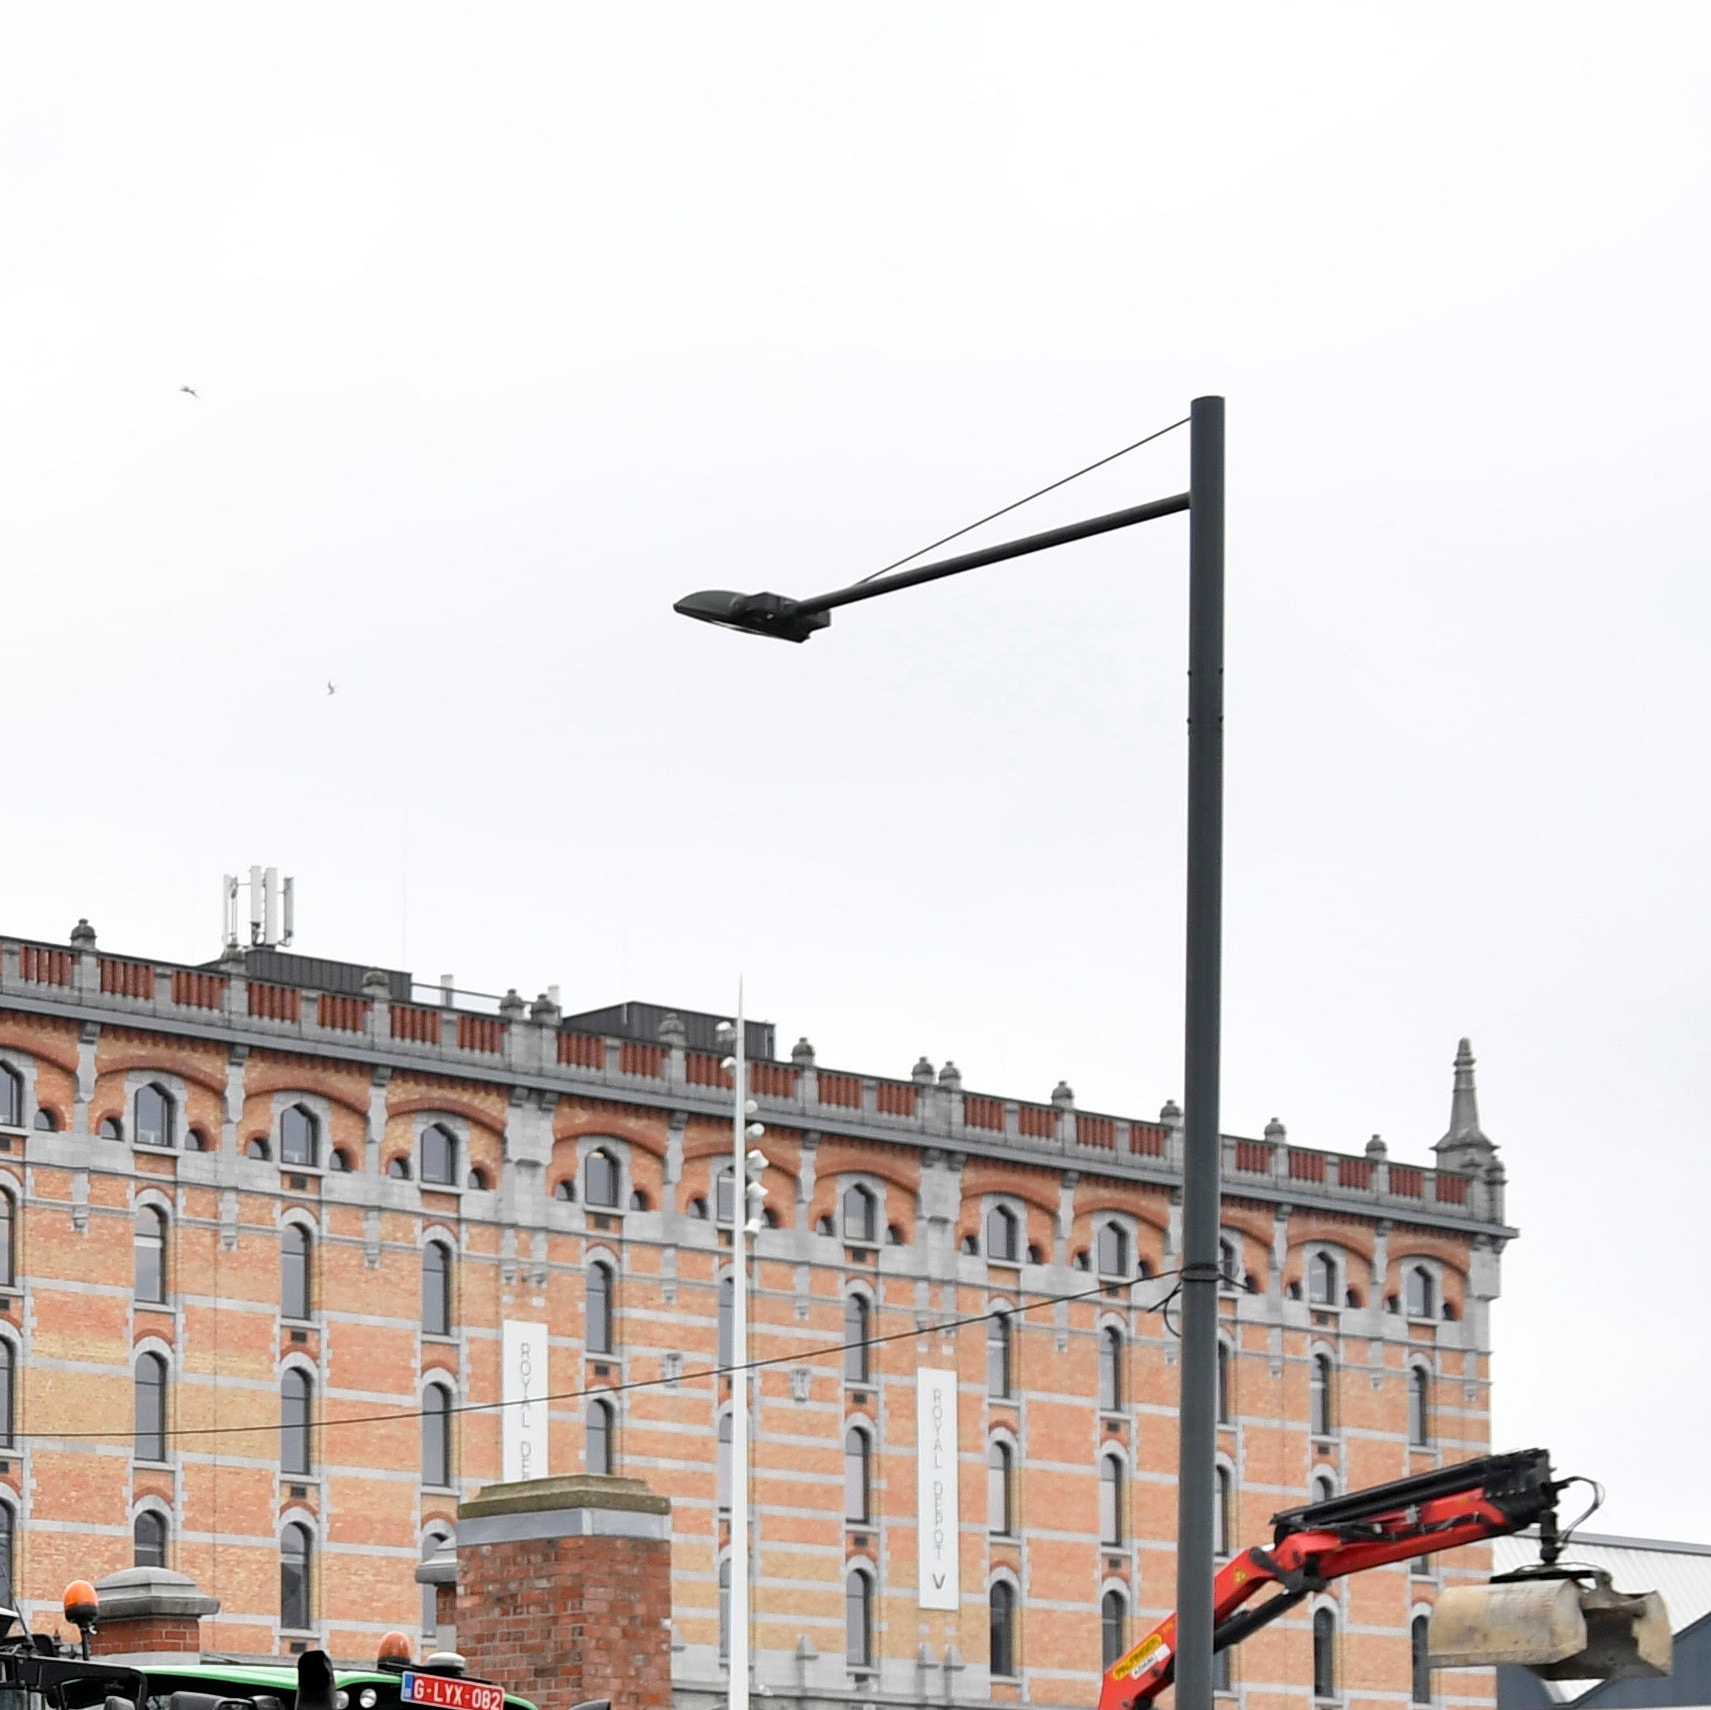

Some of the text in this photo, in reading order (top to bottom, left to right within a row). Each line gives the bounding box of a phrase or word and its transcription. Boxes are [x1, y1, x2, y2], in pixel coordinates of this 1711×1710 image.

[520, 1343, 532, 1428] ROYAL
[933, 1389, 943, 1469] ROYAL
[933, 1480, 944, 1560] DEPOT
